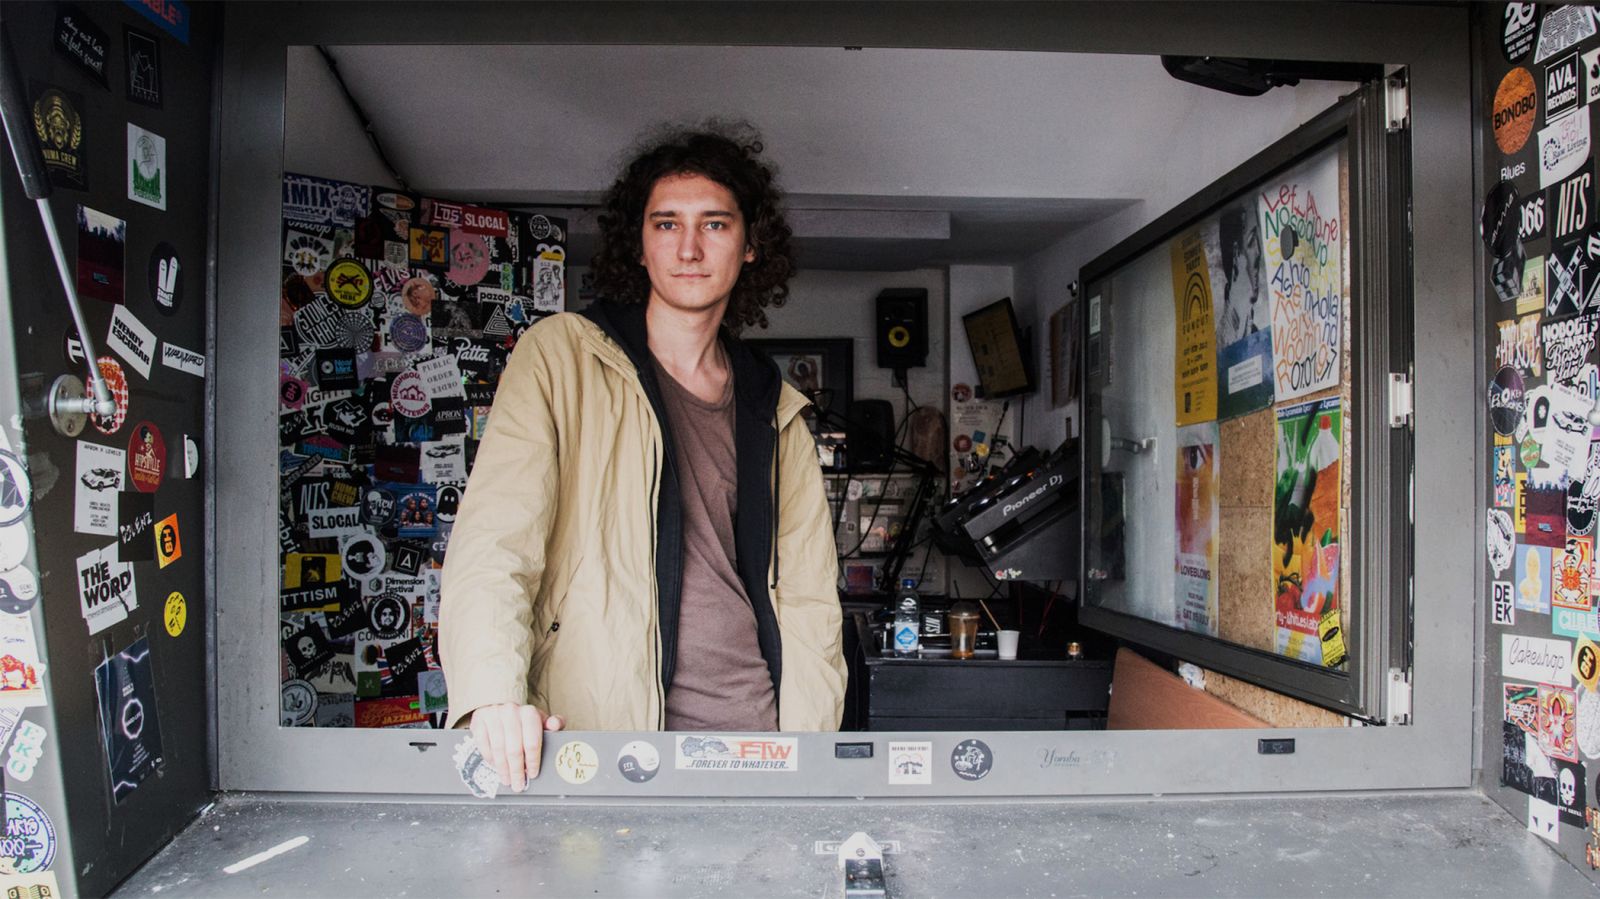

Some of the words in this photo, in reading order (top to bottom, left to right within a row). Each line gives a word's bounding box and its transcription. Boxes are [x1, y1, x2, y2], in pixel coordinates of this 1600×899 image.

[1547, 87, 1577, 111] RECORDS
[1494, 92, 1536, 129] BONOBO
[1500, 162, 1526, 181] Blues
[1556, 173, 1590, 238] NTS
[464, 213, 506, 231] SLOCAL
[373, 268, 410, 291] ELVIS
[480, 291, 511, 304] pazop
[299, 294, 340, 332] STONES
[114, 316, 144, 348] WENDY
[111, 325, 151, 366] ESCOBAR
[454, 337, 490, 363] Patta
[421, 358, 451, 373] PUBLIC
[426, 370, 453, 384] ORDER
[394, 401, 431, 416] PATTERNS
[301, 481, 330, 515] NTS
[1003, 483, 1048, 516] Pioneer
[120, 511, 153, 544] POLENZ
[312, 513, 360, 530] SLOCAL
[81, 561, 111, 590] THE
[386, 577, 425, 586] Dimension
[84, 569, 132, 609] WORD
[386, 585, 414, 593] Festival
[1494, 584, 1511, 603] DE
[1495, 603, 1512, 623] EK
[1510, 638, 1565, 681] Cakeshop
[383, 713, 424, 724] JAZZMAN
[740, 741, 792, 760] FTW
[1040, 748, 1081, 769] Yoruba
[729, 760, 740, 768] TO
